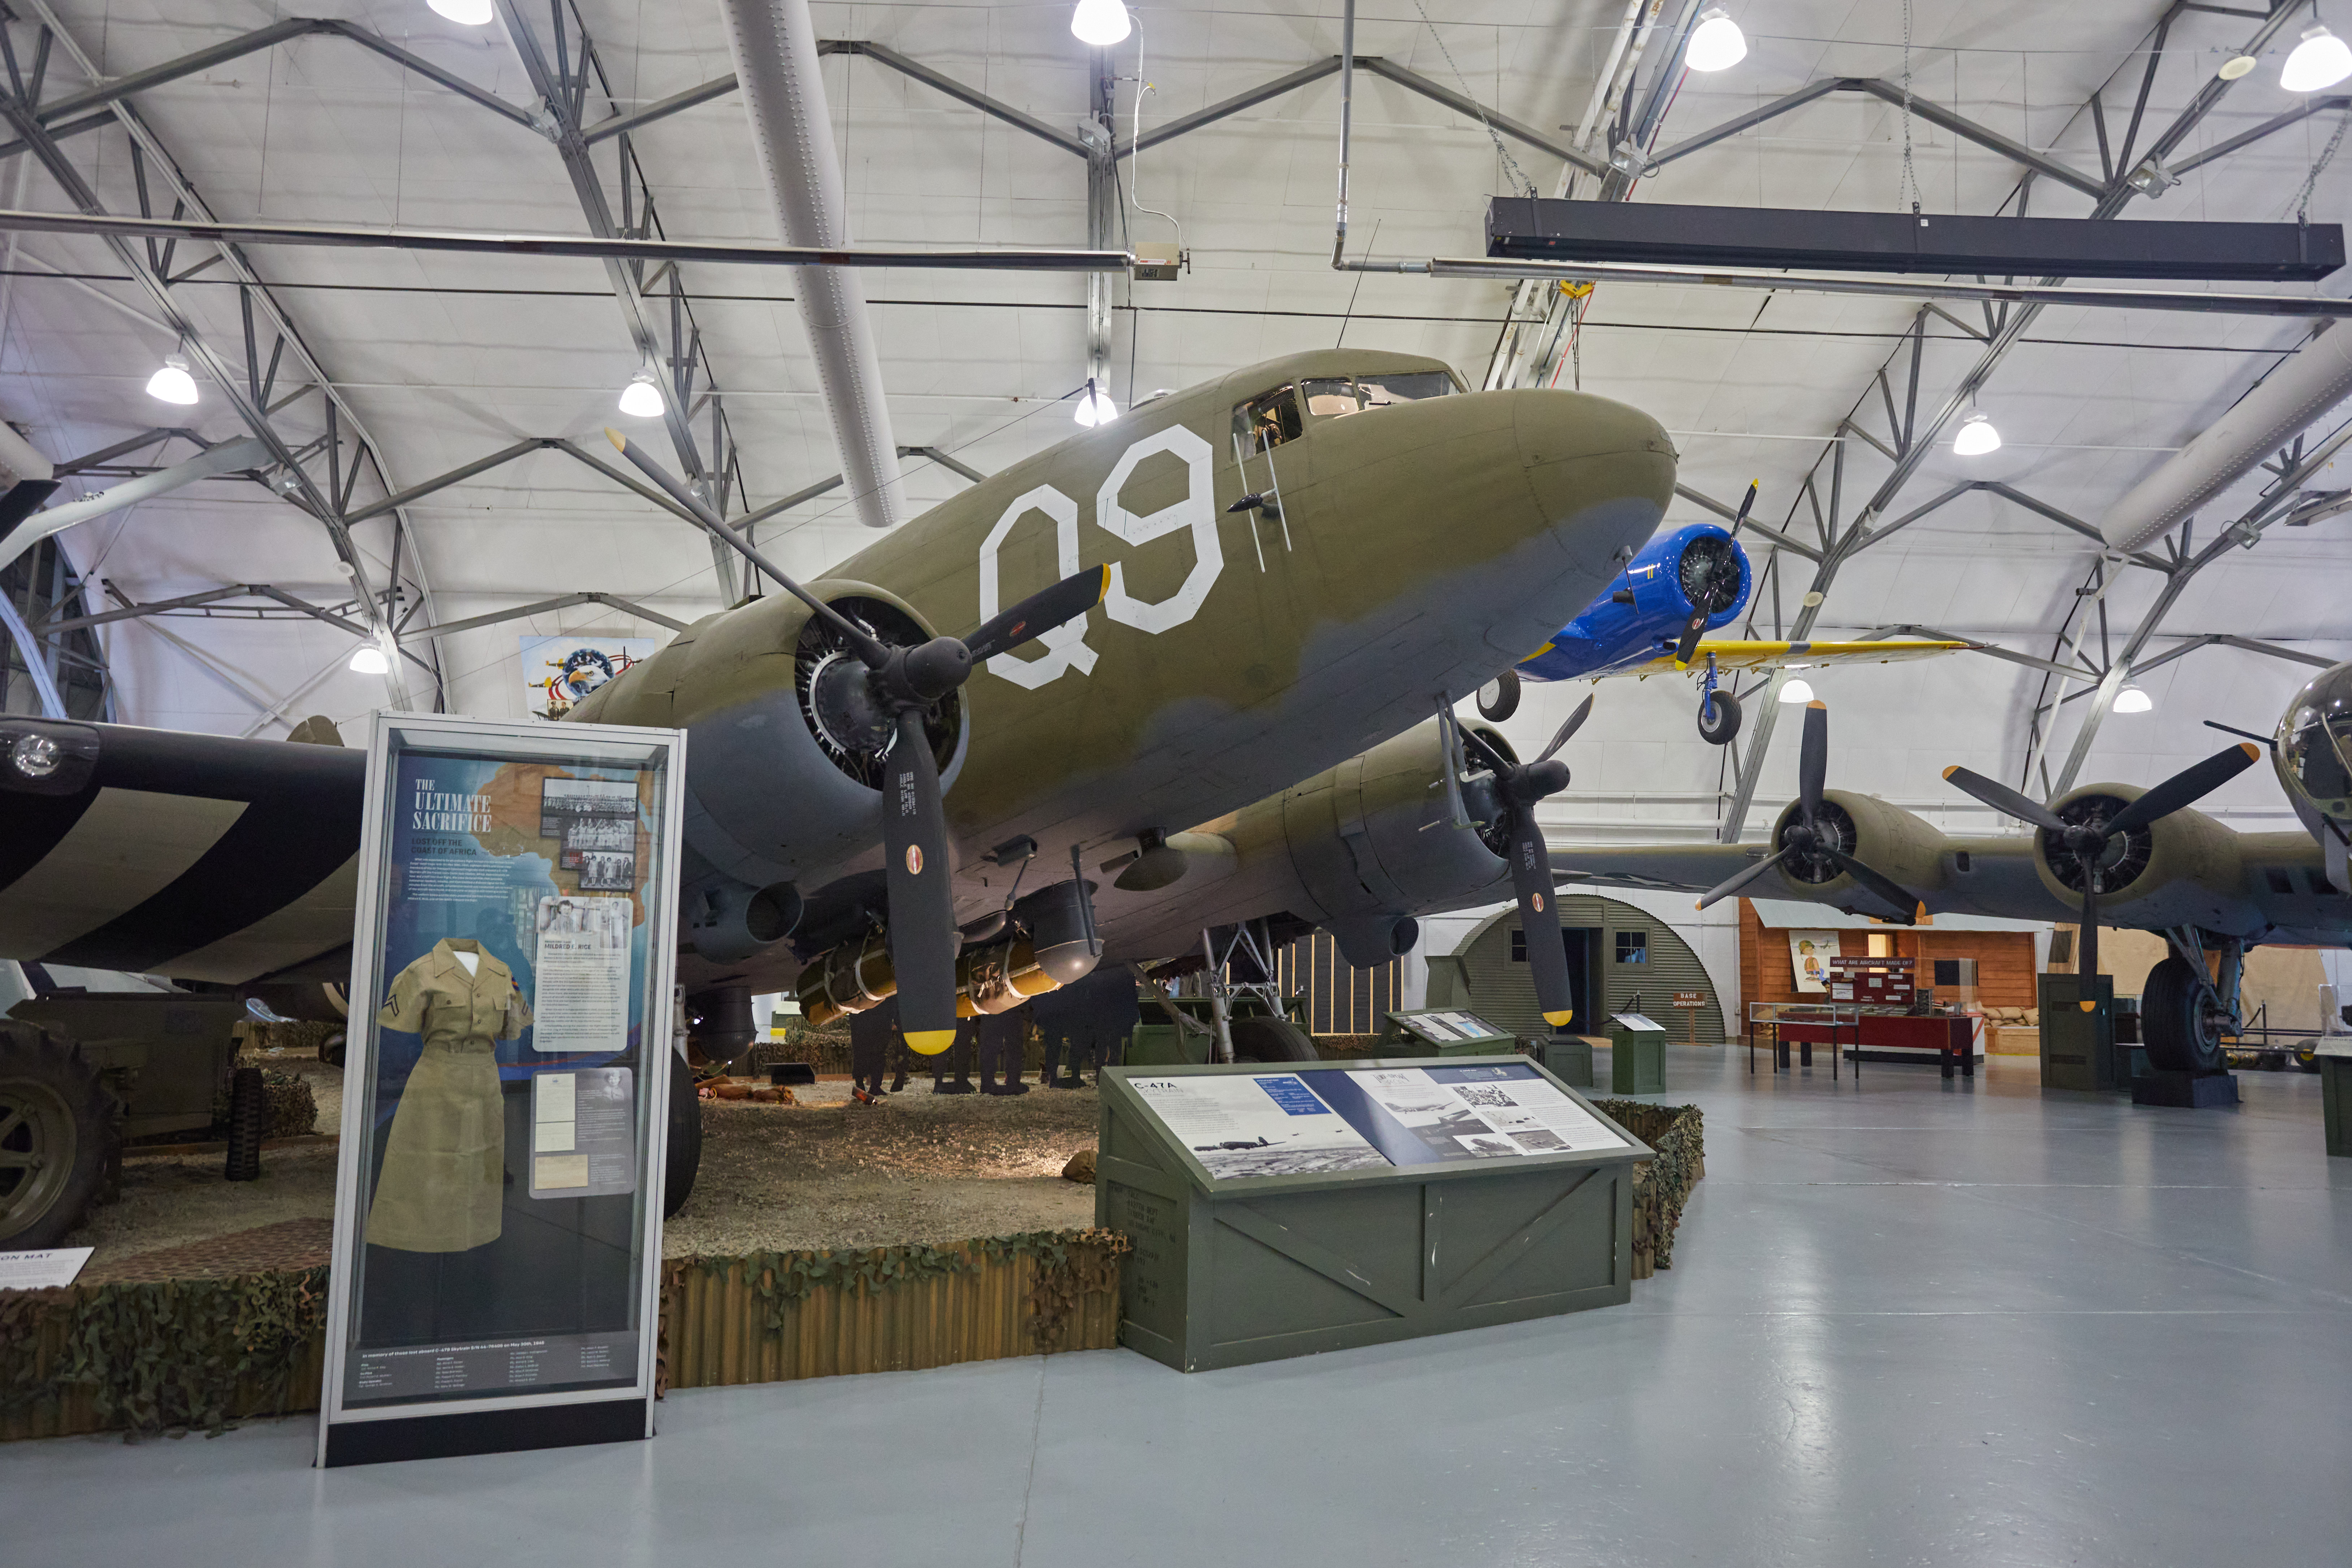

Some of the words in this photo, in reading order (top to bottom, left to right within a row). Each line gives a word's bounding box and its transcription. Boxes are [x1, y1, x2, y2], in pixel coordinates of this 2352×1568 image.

[416, 779, 435, 791] THE
[415, 792, 491, 813] ULTIMATE
[413, 811, 492, 832] SACRIFICE
